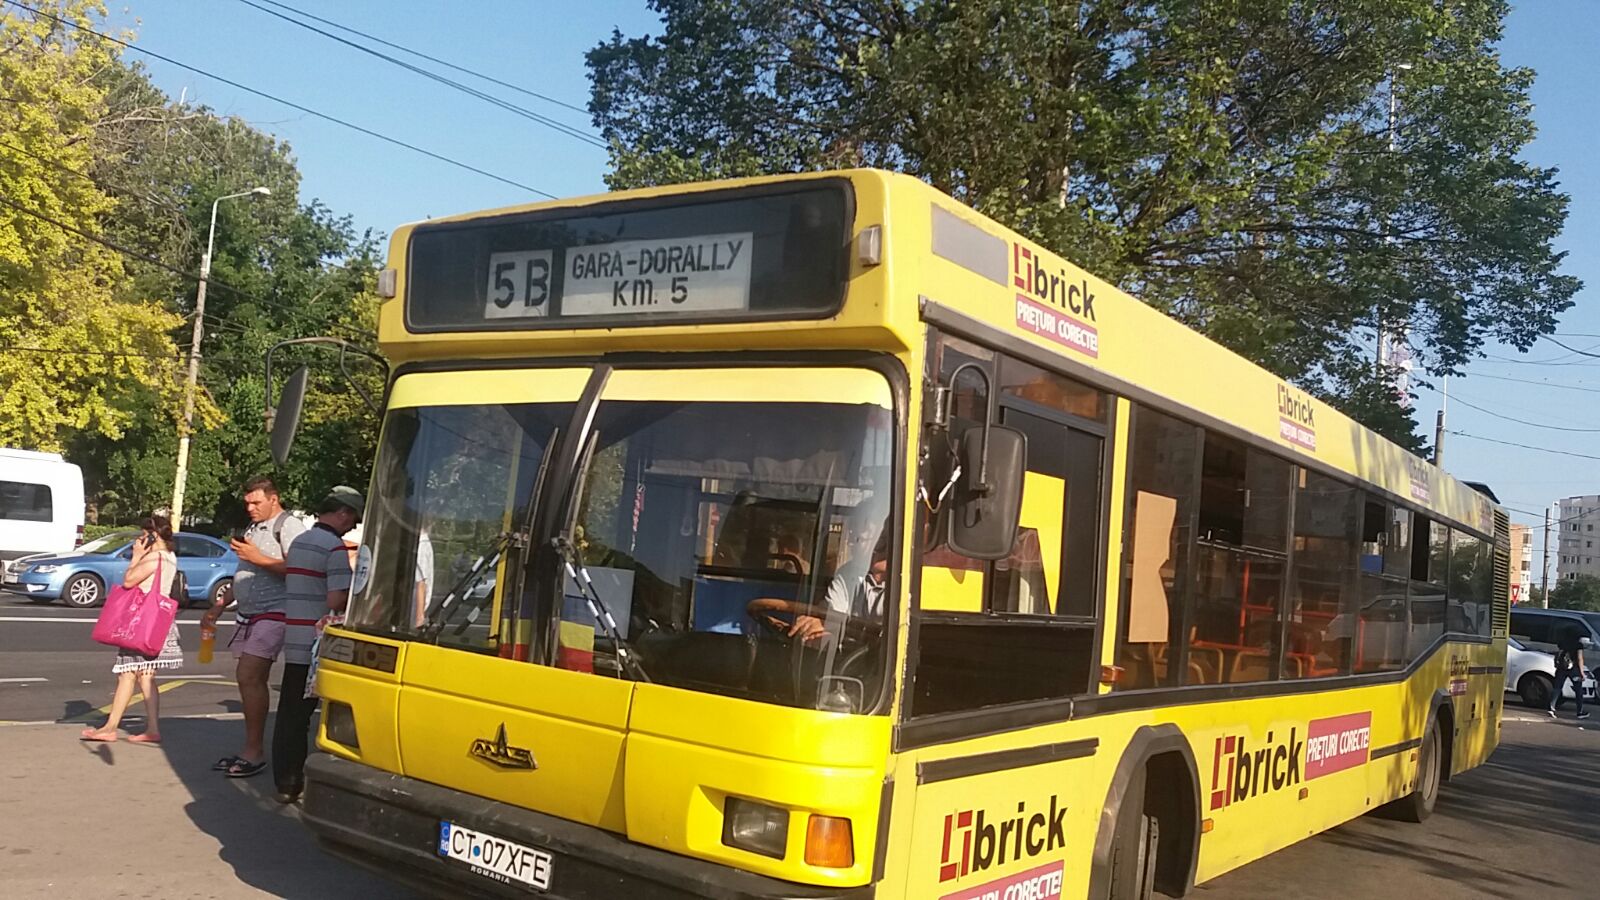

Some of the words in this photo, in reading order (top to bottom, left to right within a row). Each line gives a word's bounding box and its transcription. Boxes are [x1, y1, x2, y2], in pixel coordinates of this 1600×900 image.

[572, 240, 743, 280] GARA-DORALLY
[671, 276, 689, 304] 5
[470, 865, 511, 885] ROMANIA
